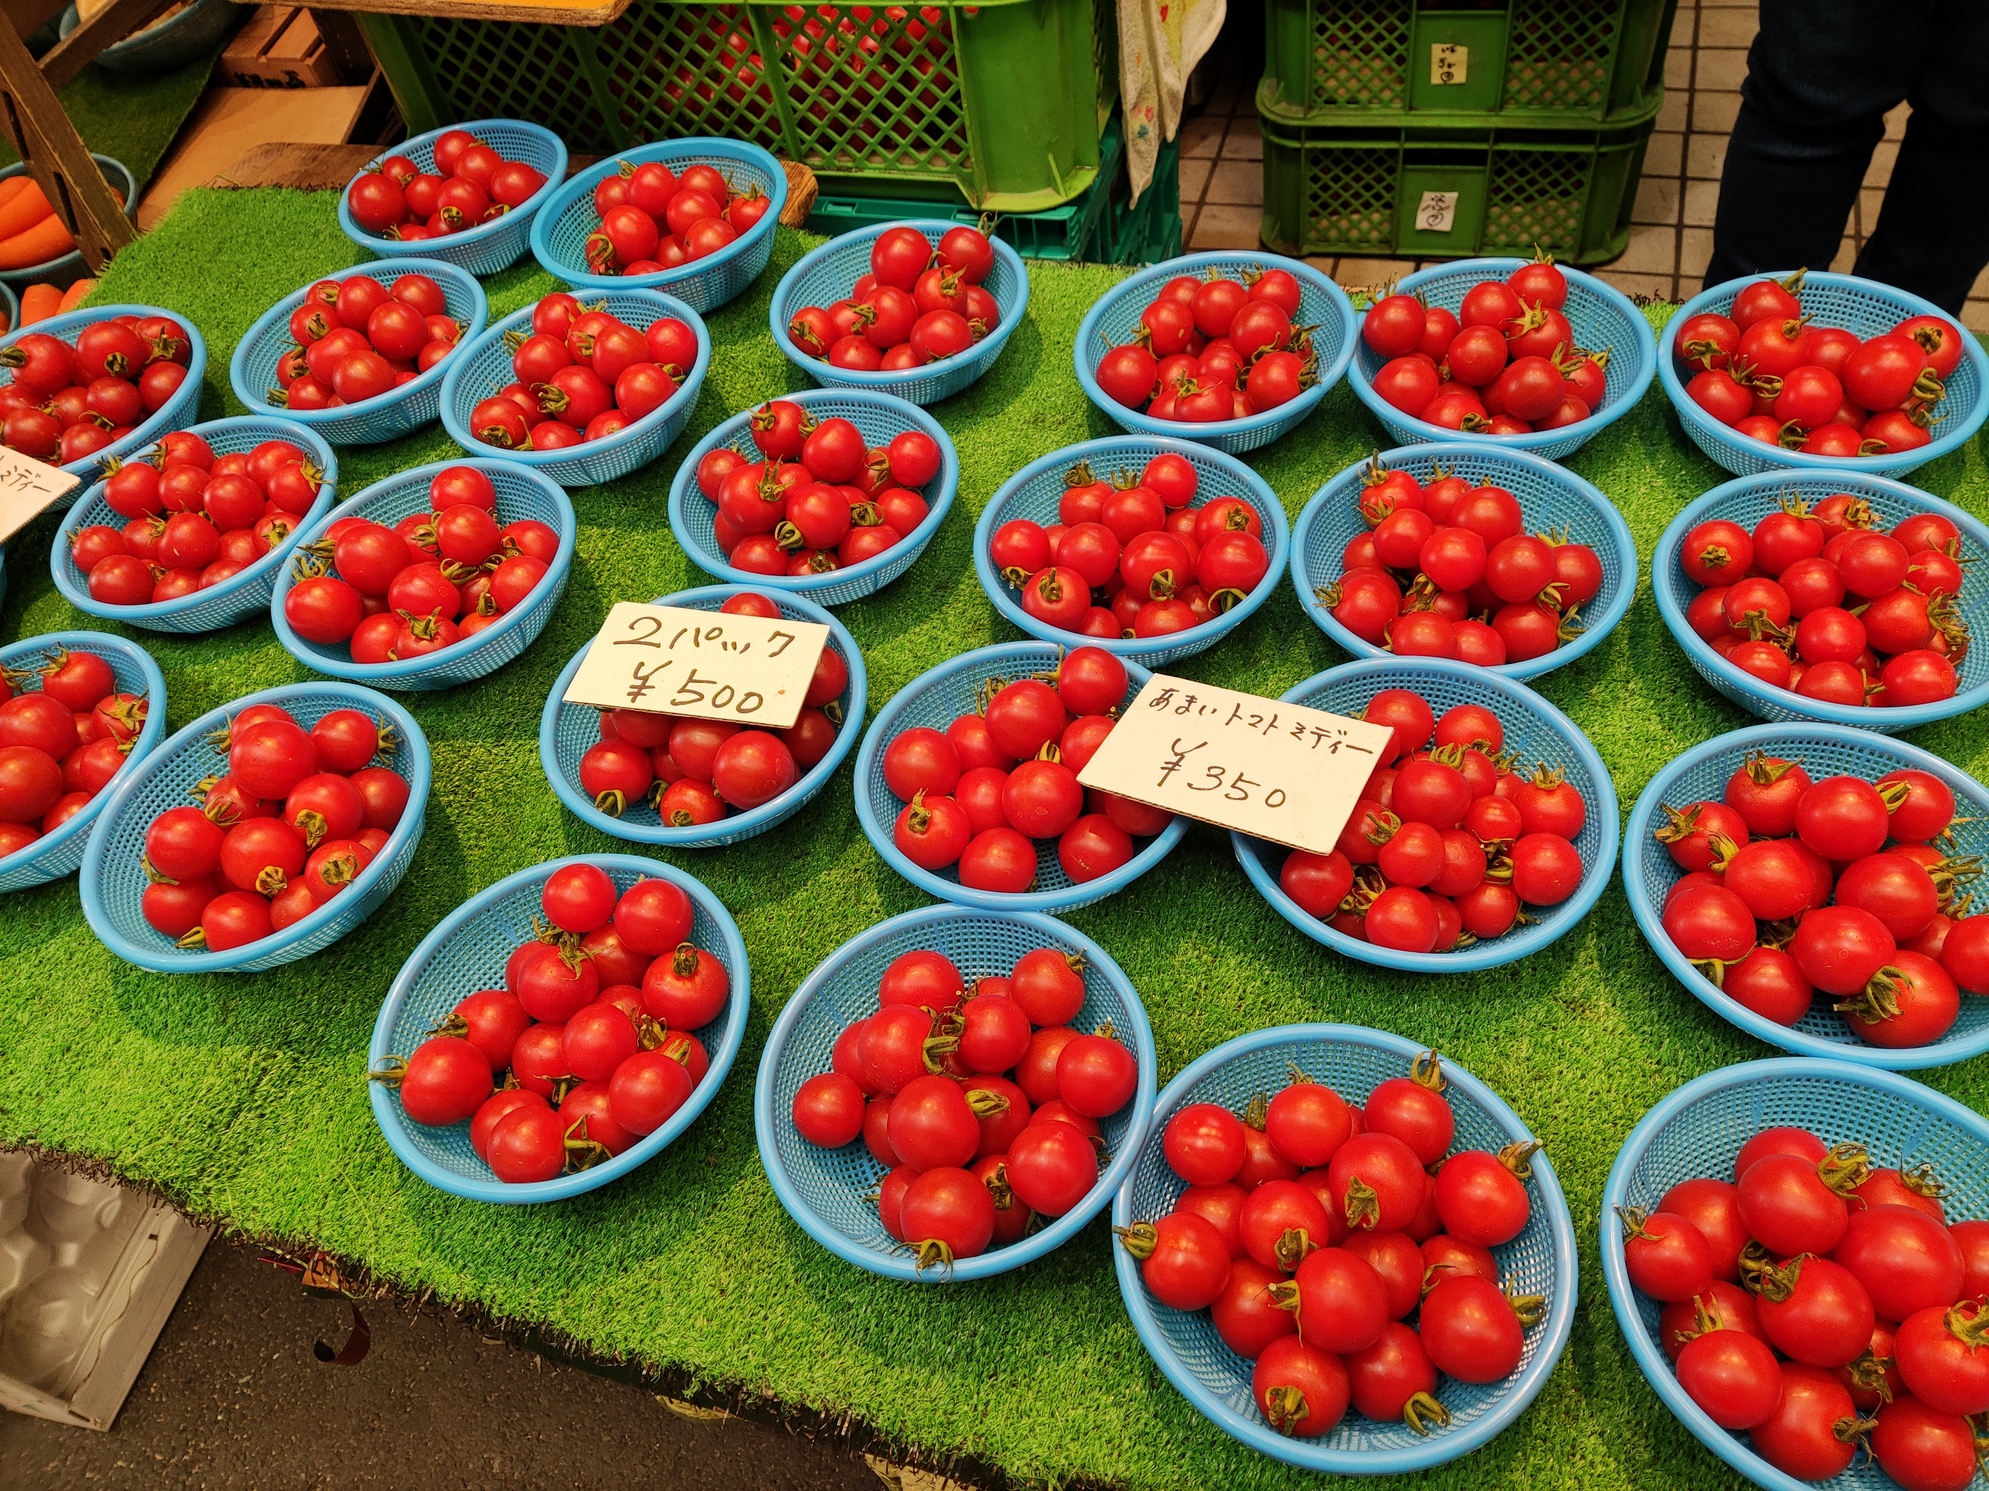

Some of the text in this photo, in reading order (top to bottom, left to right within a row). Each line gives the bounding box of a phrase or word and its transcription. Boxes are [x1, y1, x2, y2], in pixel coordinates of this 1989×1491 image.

[0, 455, 52, 493] ミディー
[613, 616, 796, 658] 2パック
[626, 660, 764, 714] ¥500
[1156, 737, 1287, 808] ¥350
